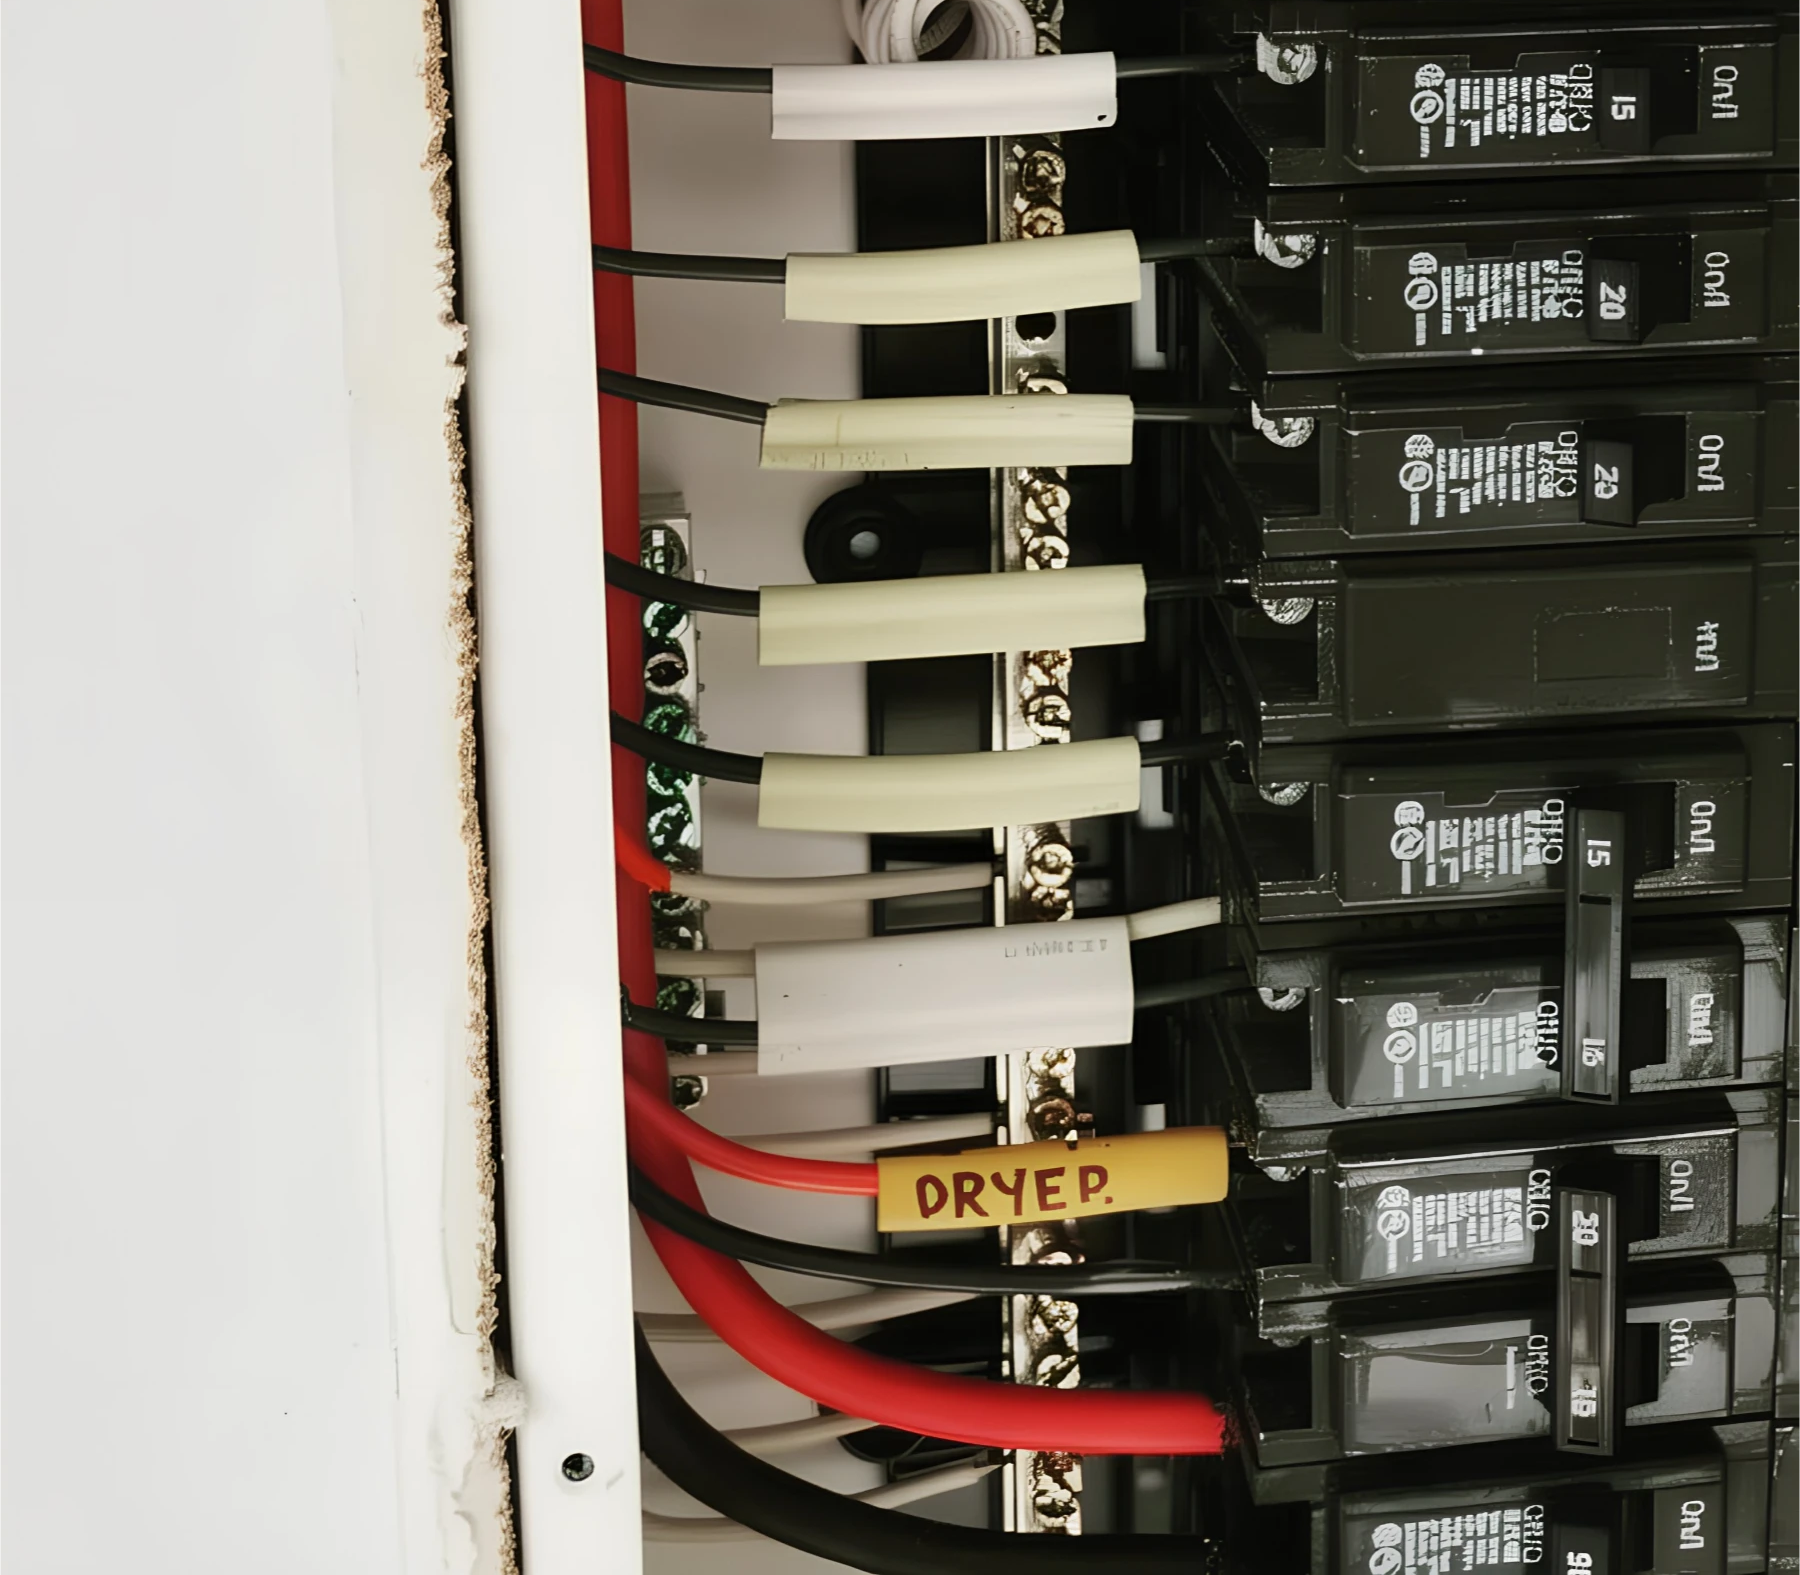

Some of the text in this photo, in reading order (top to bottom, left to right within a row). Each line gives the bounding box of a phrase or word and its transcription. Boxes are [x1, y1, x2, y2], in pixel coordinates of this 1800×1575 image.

[1611, 95, 1637, 120] 15
[1600, 281, 1627, 320] 20
[1587, 839, 1612, 868] 15
